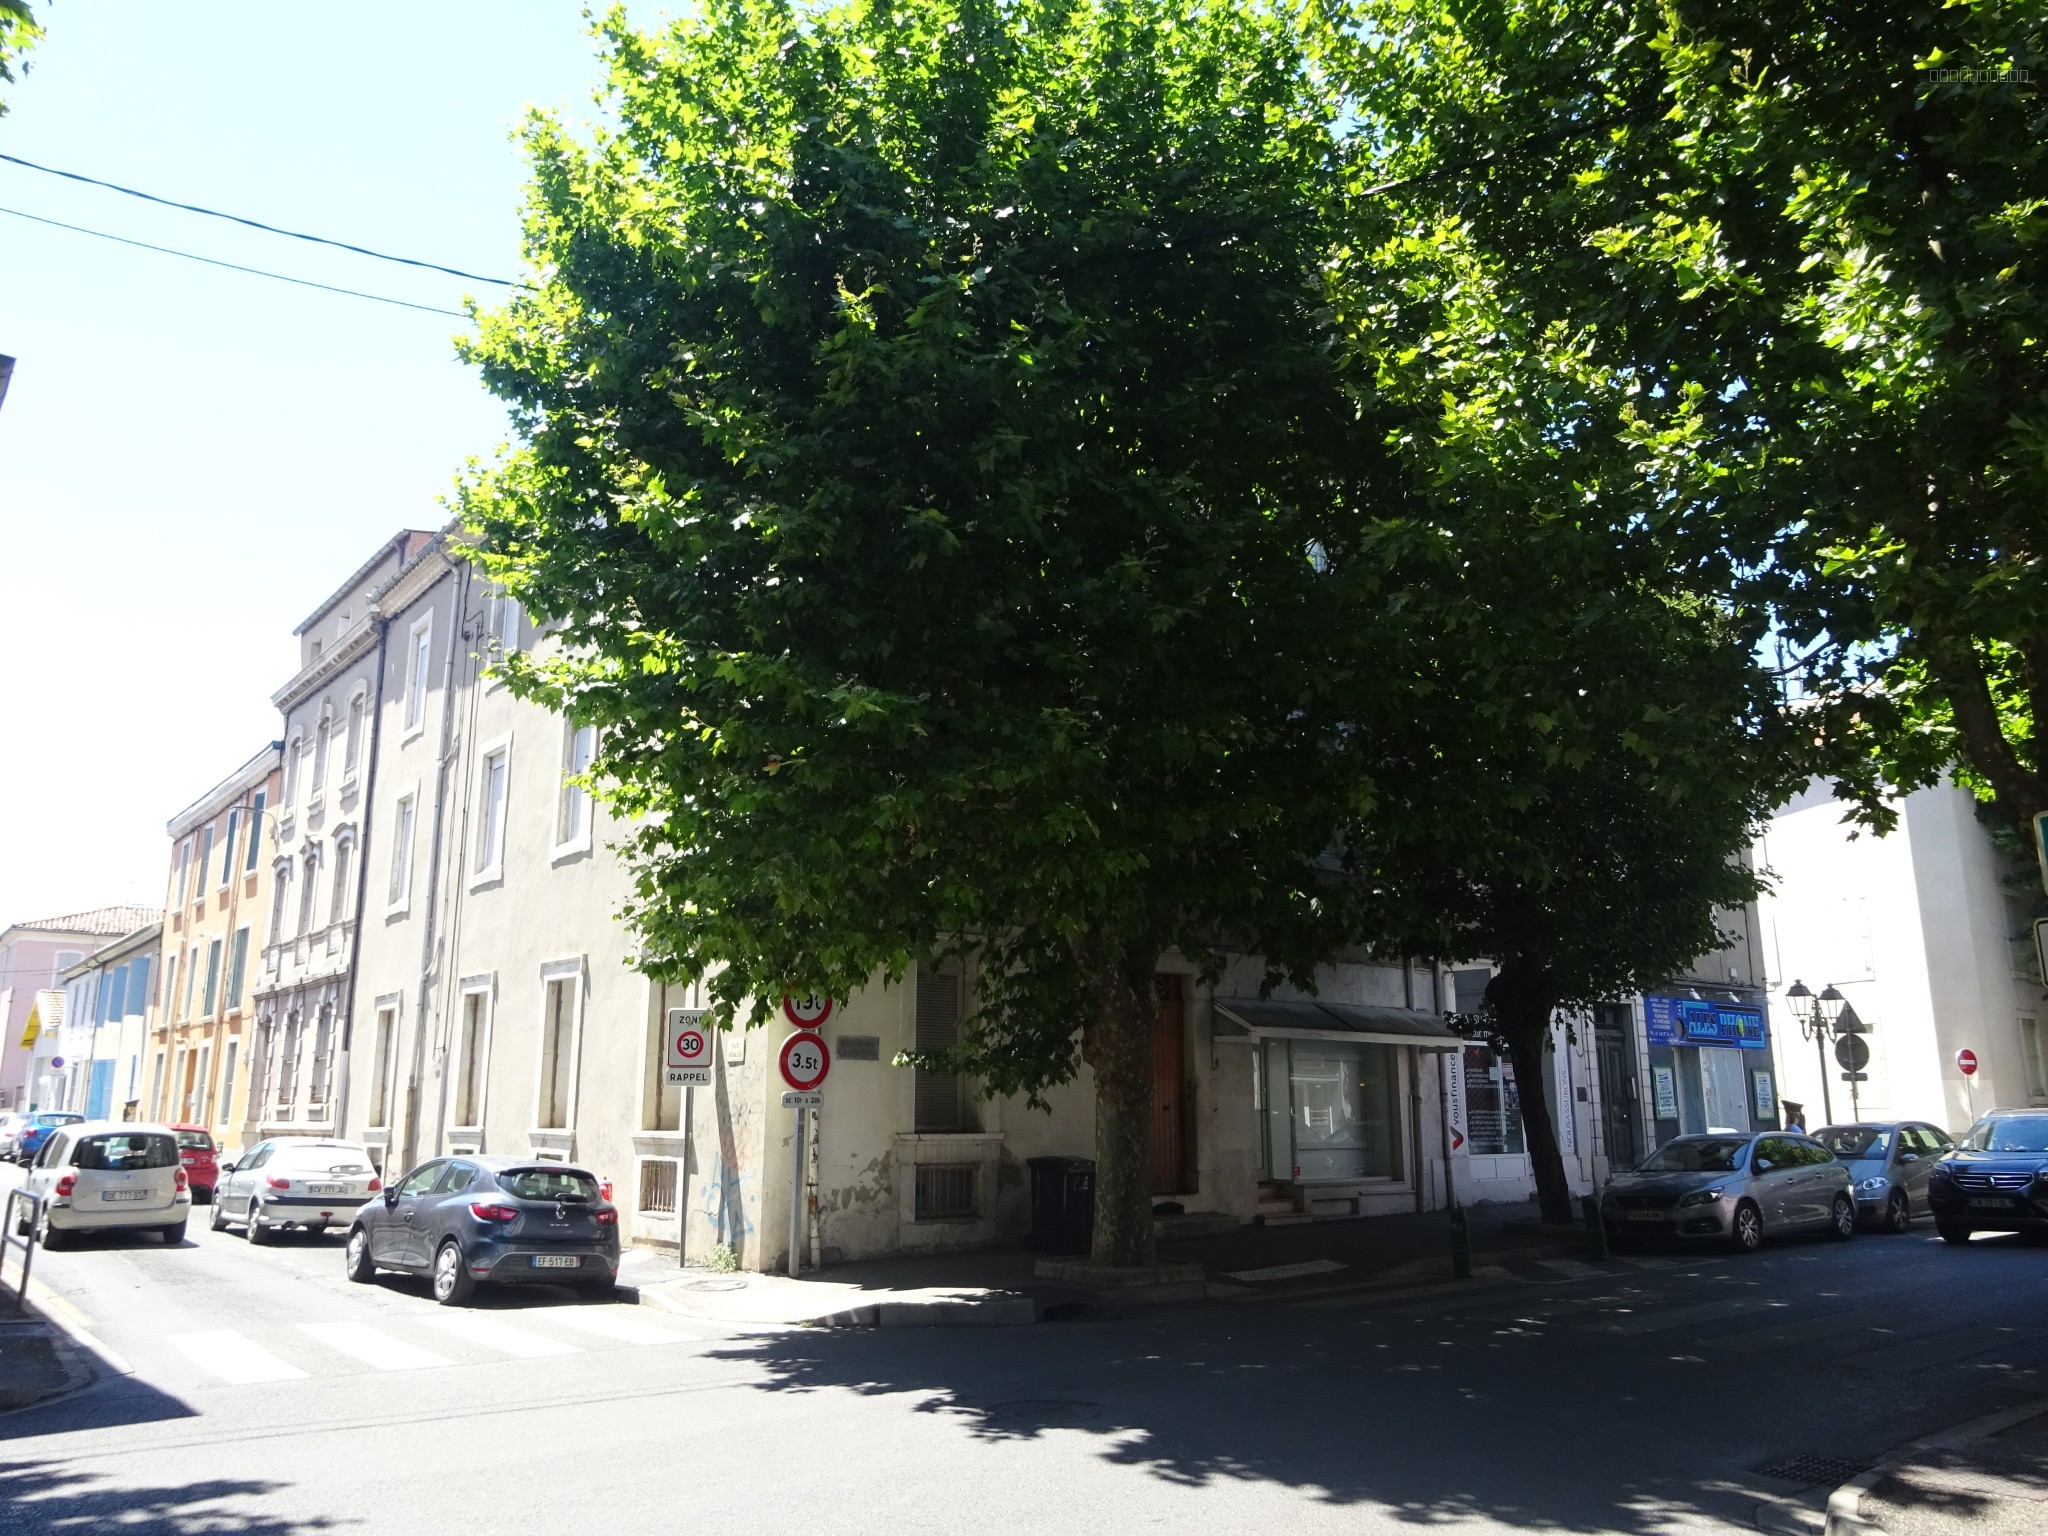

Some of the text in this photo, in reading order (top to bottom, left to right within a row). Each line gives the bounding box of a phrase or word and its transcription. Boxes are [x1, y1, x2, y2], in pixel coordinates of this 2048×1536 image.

[679, 1015, 702, 1024] ZON
[1689, 1011, 1760, 1038] ALES PHONE
[682, 1038, 699, 1051] 30
[792, 1053, 818, 1070] 3.5t
[670, 1073, 707, 1082] RAPPEL
